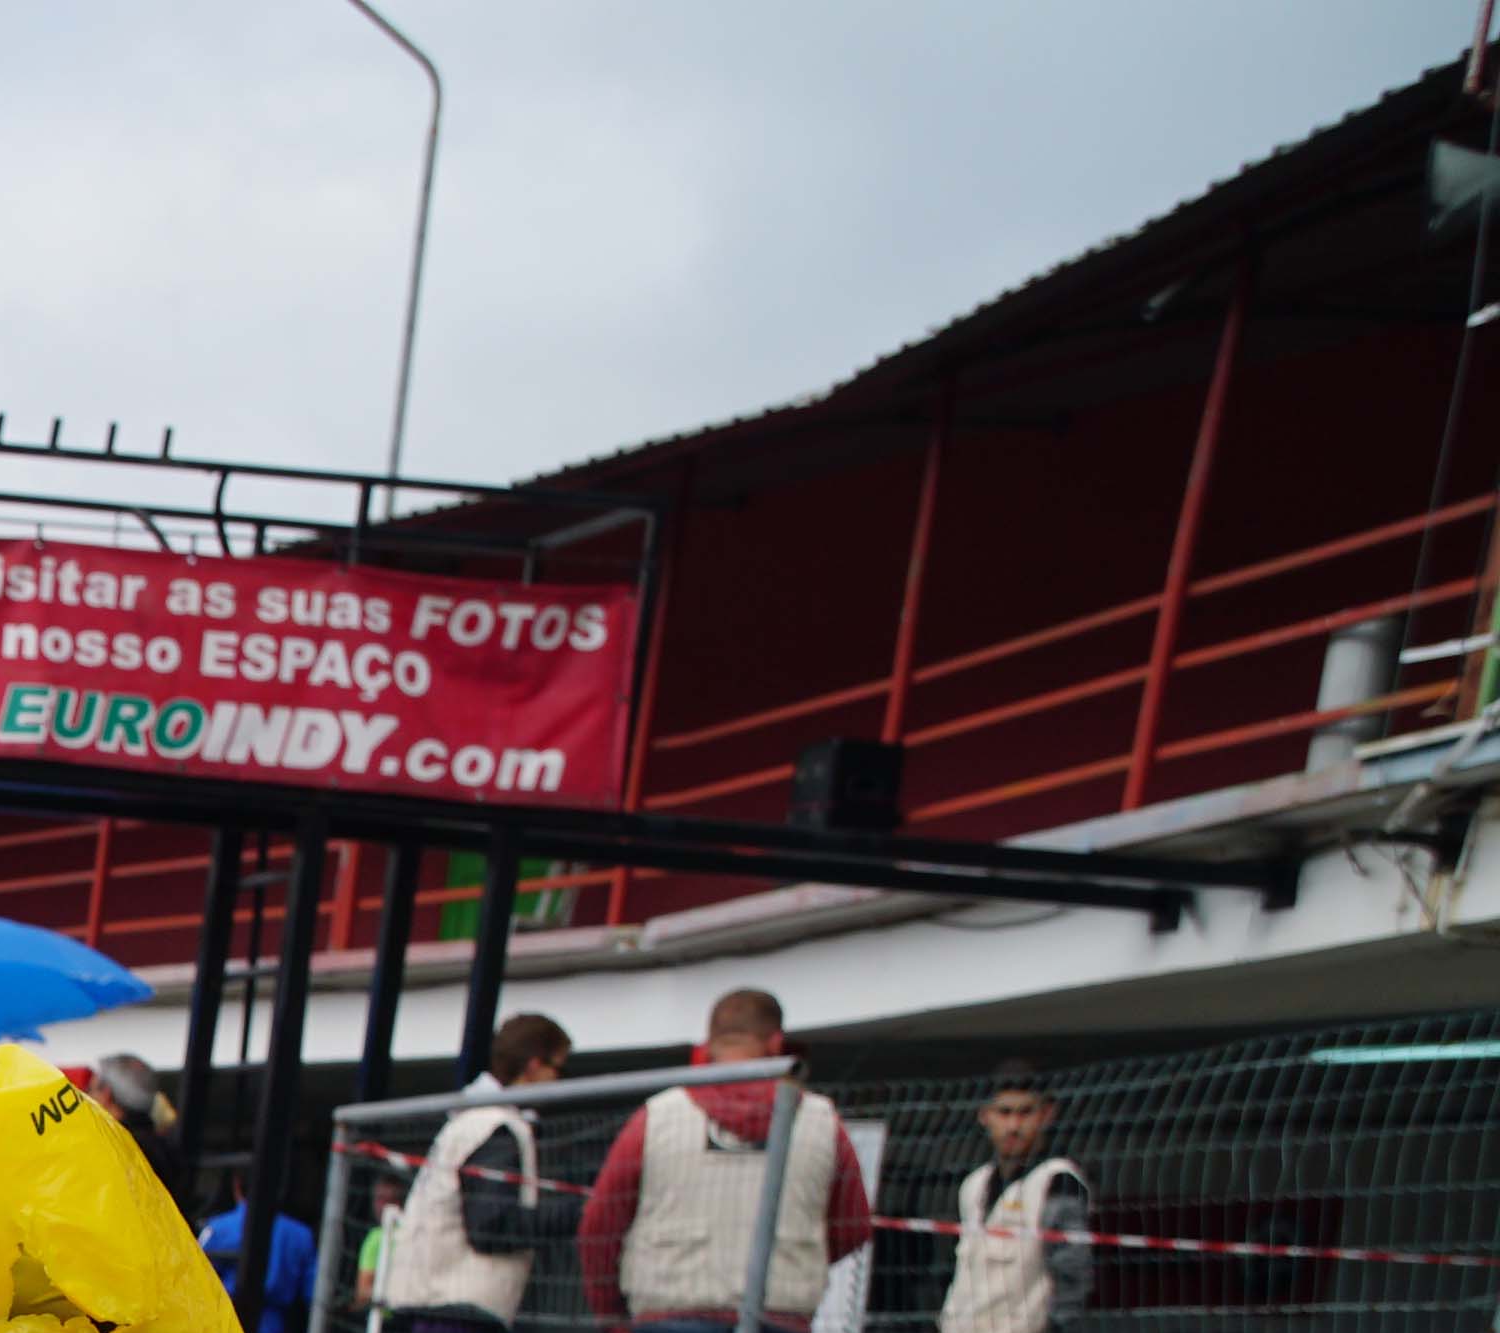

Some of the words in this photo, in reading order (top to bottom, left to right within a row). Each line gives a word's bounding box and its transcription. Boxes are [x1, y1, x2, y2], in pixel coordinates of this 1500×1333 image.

[166, 578, 237, 619] as
[256, 588, 393, 634] suas
[410, 592, 610, 655] FOTOS
[0, 624, 181, 675] nosso
[199, 630, 432, 703] ESPAÇO
